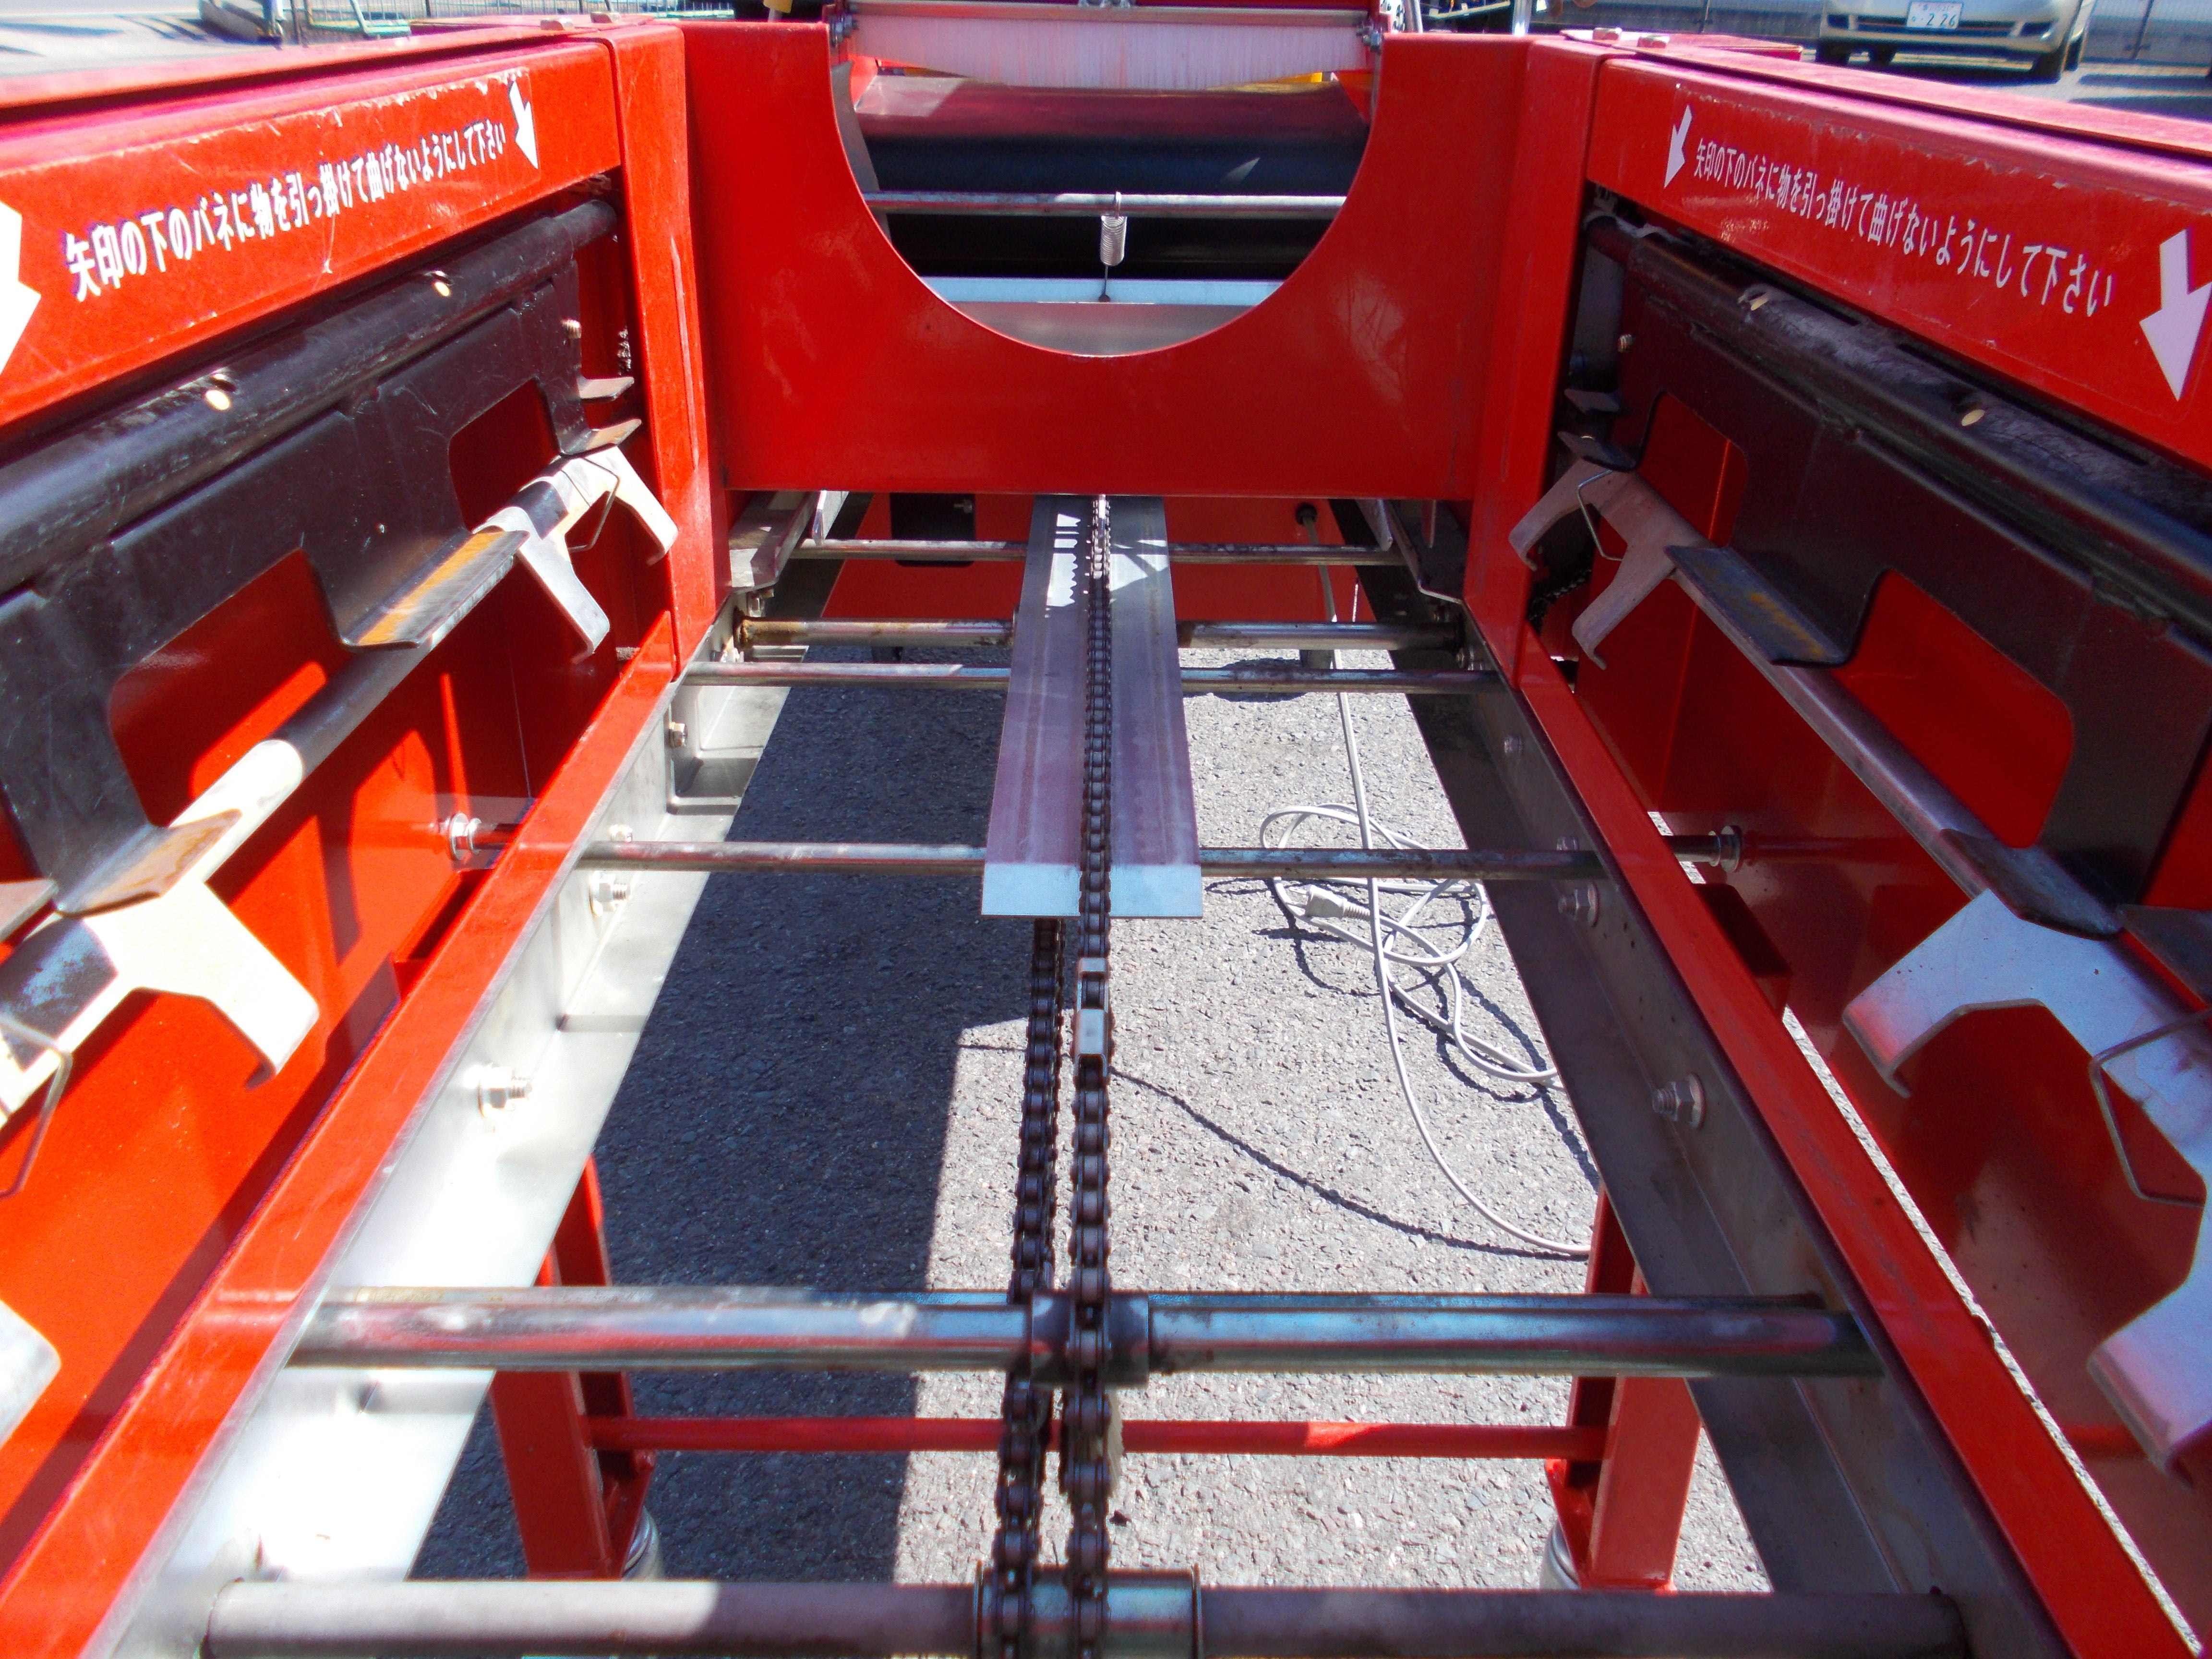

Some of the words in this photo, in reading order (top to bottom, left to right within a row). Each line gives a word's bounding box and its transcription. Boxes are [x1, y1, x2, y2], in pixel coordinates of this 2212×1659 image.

[65, 119, 505, 301] 矢印の下のバネに物を引っ掛けて曲げないようにして下さい
[1694, 138, 2112, 317] 矢印の下のバネに物を引っ掛けて曲げないようにして下さい
